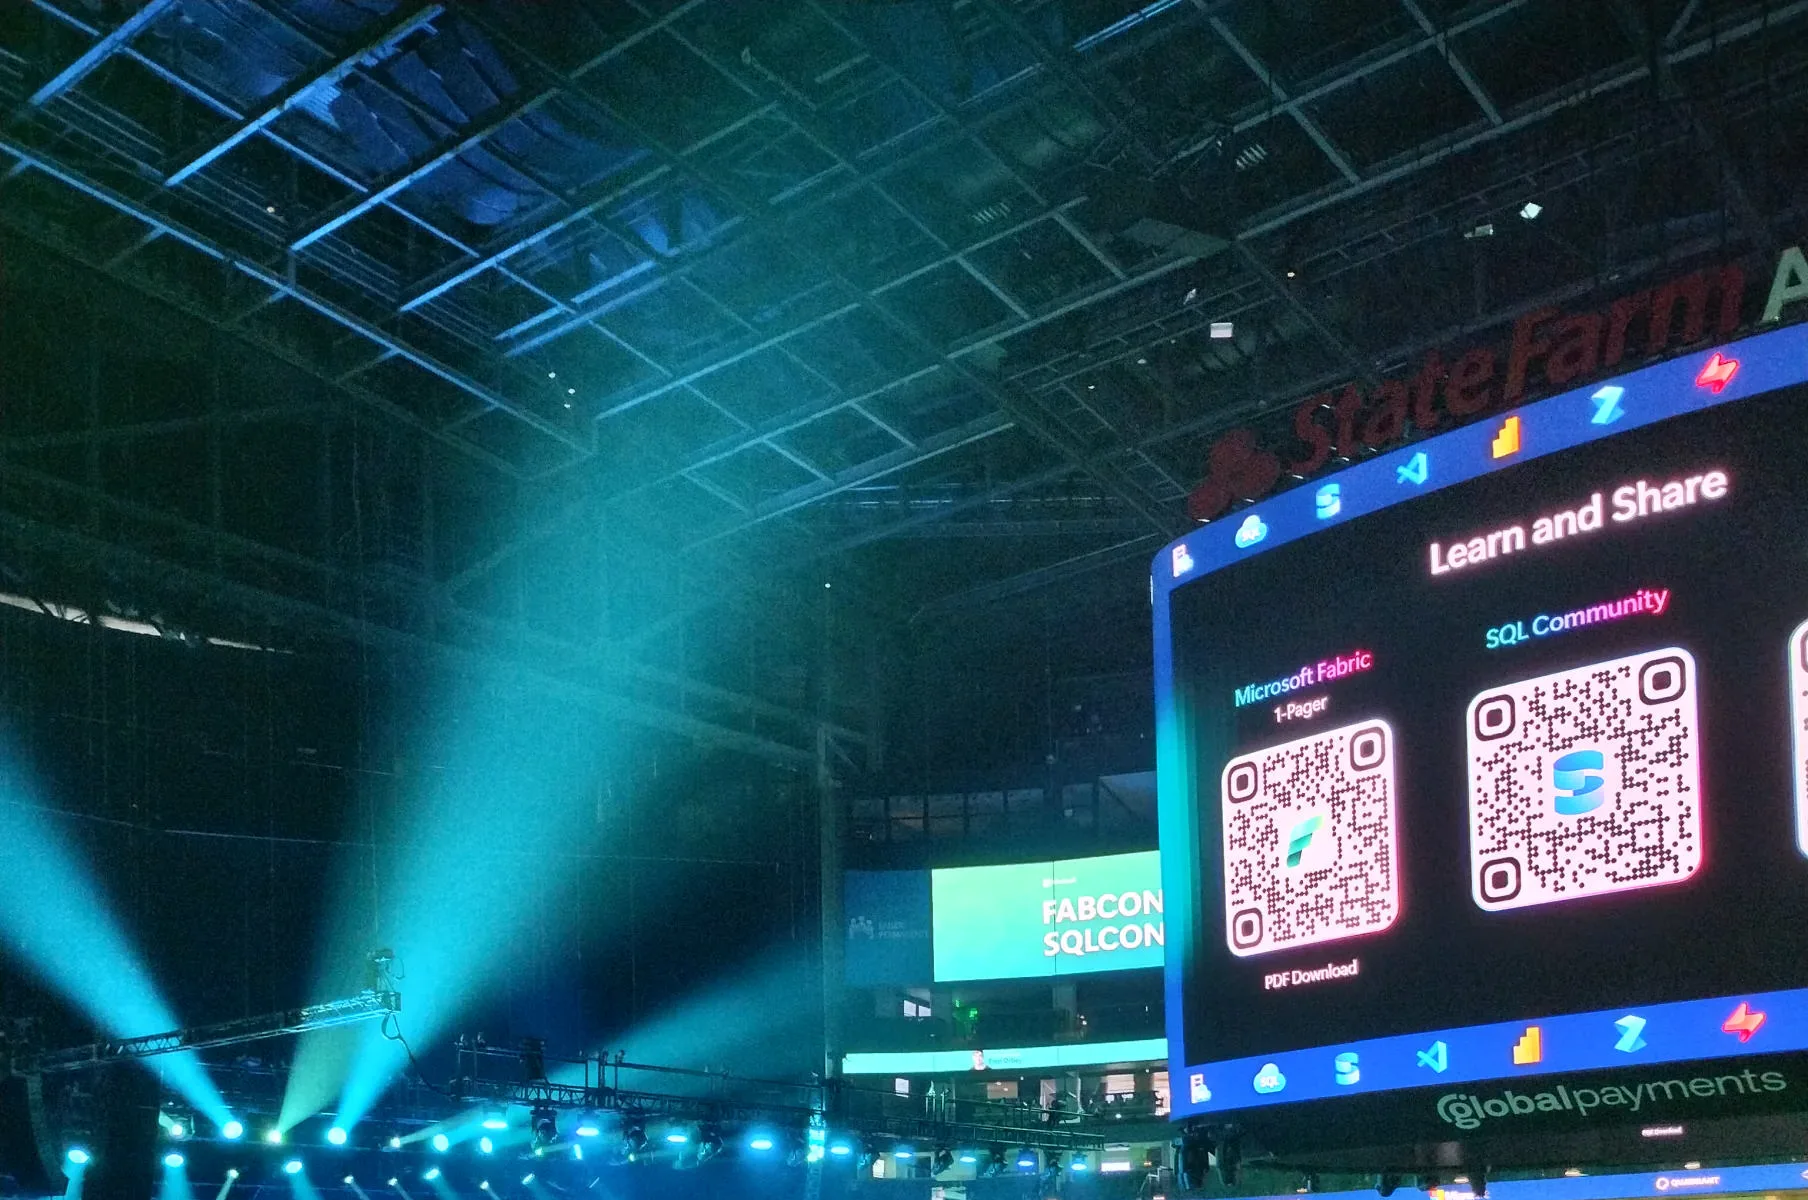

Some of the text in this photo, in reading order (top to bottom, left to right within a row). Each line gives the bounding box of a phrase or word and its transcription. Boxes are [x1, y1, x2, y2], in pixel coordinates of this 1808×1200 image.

[1430, 470, 1729, 576] Learn and Share
[1486, 588, 1669, 649] SQL Community
[1234, 650, 1371, 708] Microsoft Fabric
[1274, 696, 1328, 723] 1-Pager
[1042, 888, 1163, 925] FABCON
[1043, 921, 1164, 957] SQLCON
[1264, 958, 1359, 990] PDF Download
